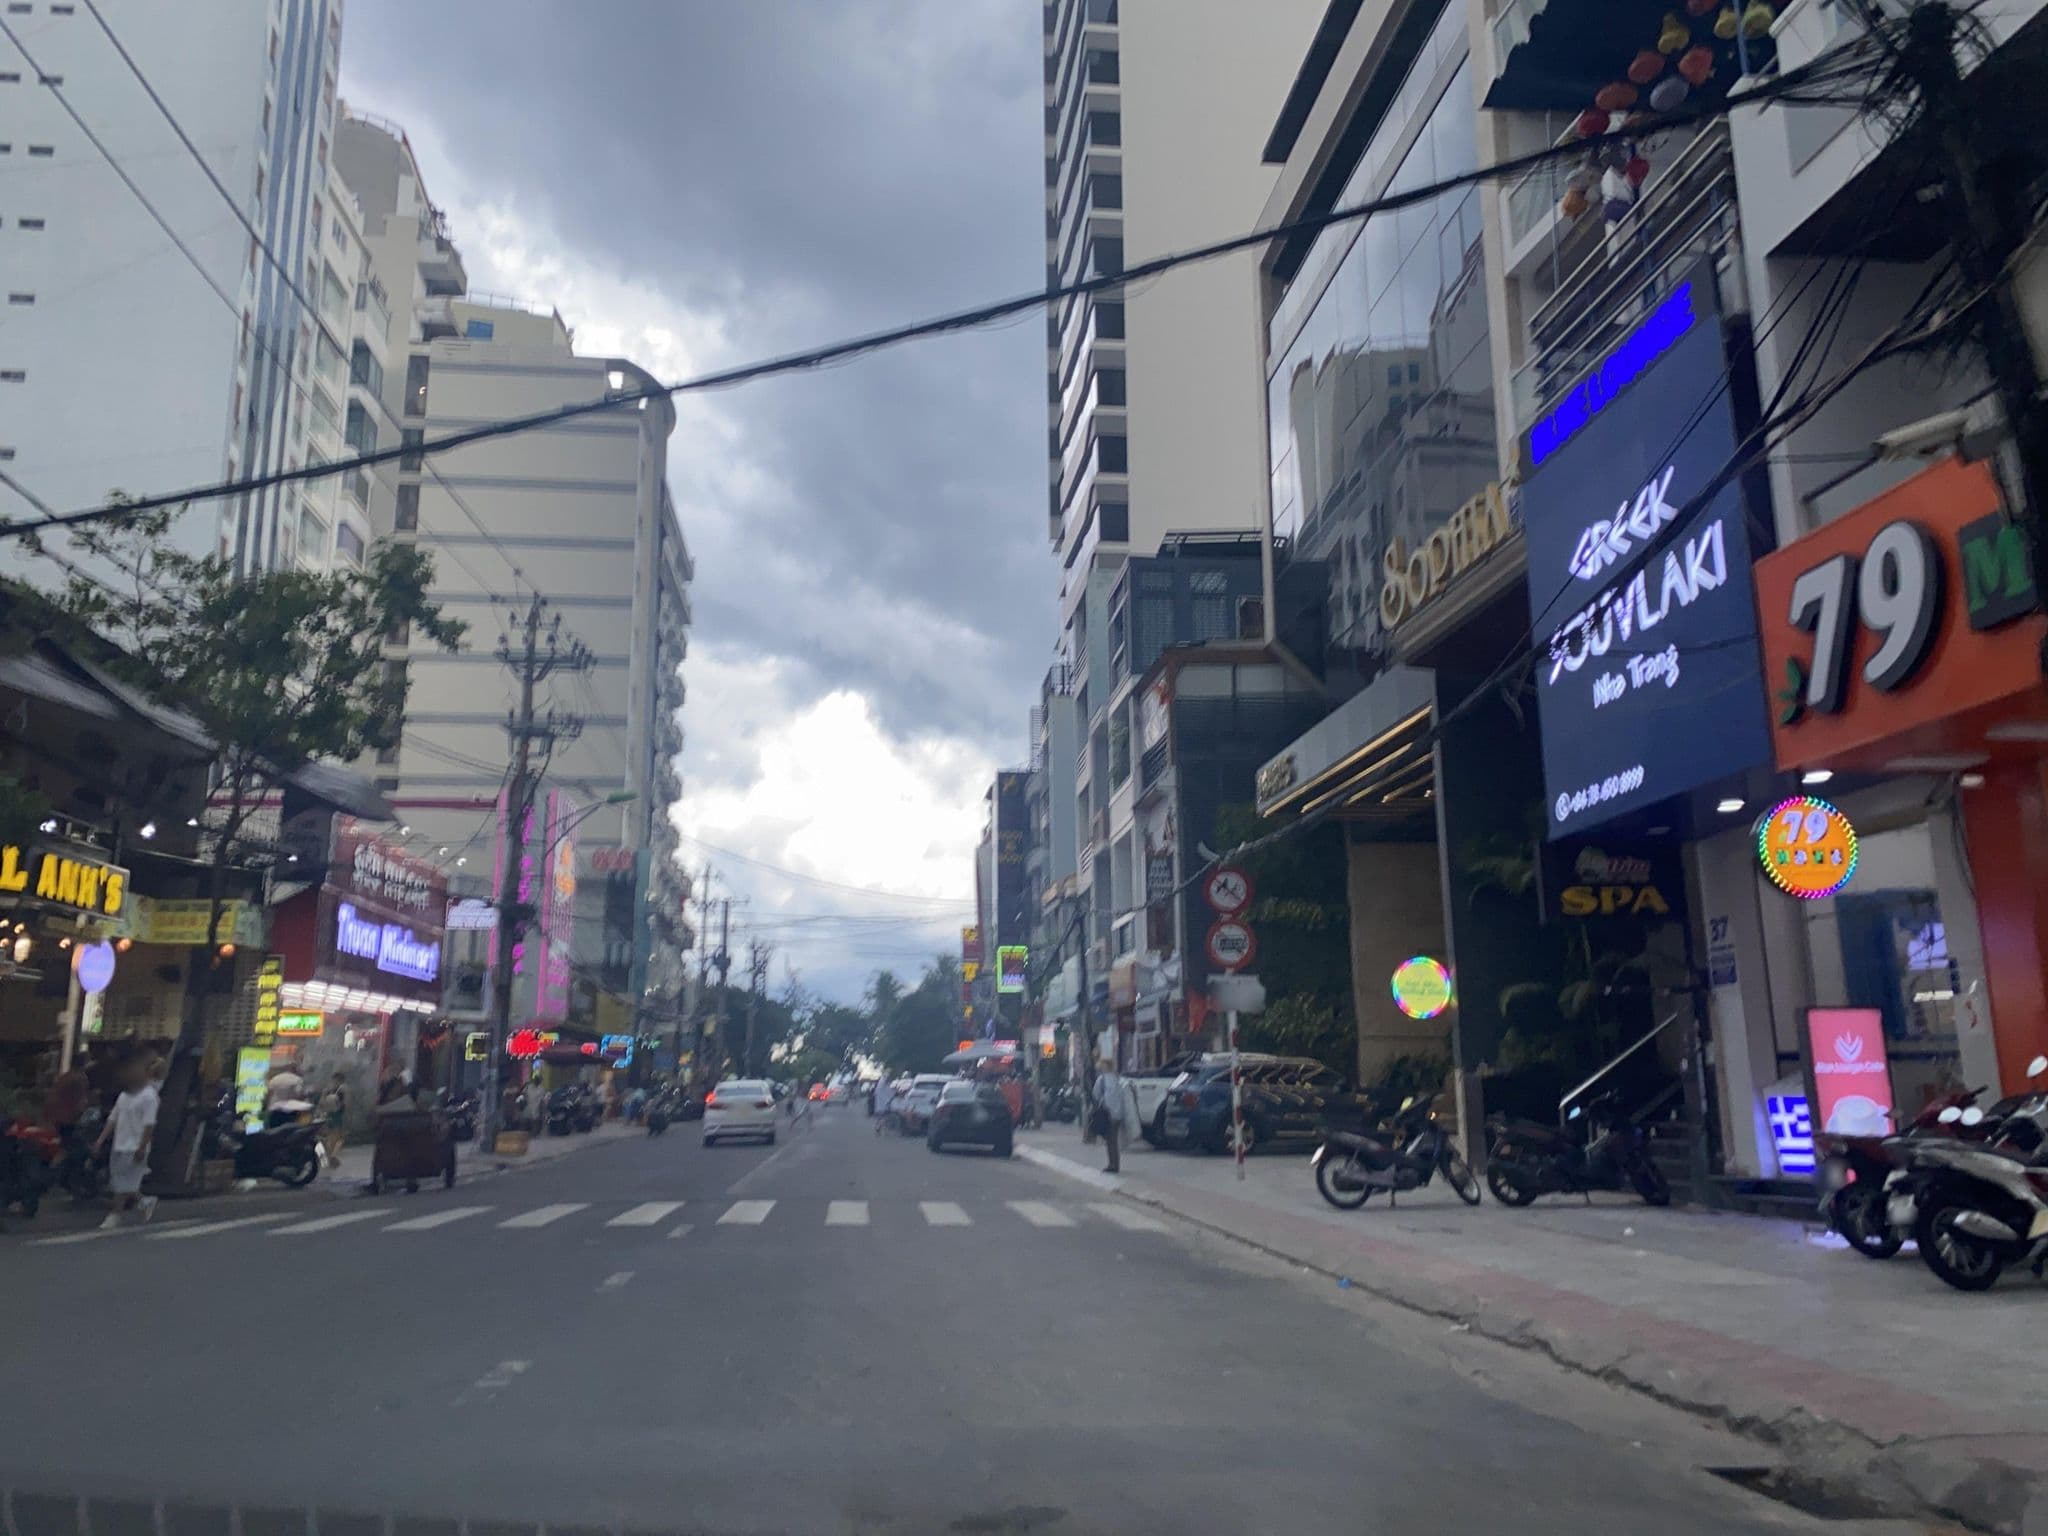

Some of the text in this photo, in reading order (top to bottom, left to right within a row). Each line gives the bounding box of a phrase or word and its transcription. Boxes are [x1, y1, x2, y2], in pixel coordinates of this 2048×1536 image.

[1568, 465, 1679, 581] GREEK
[1790, 520, 1936, 714] 79
[1627, 643, 1680, 688] Trang
[1781, 810, 1829, 845] 79
[35, 853, 124, 915] ANH'S
[1560, 885, 1670, 916] SPA
